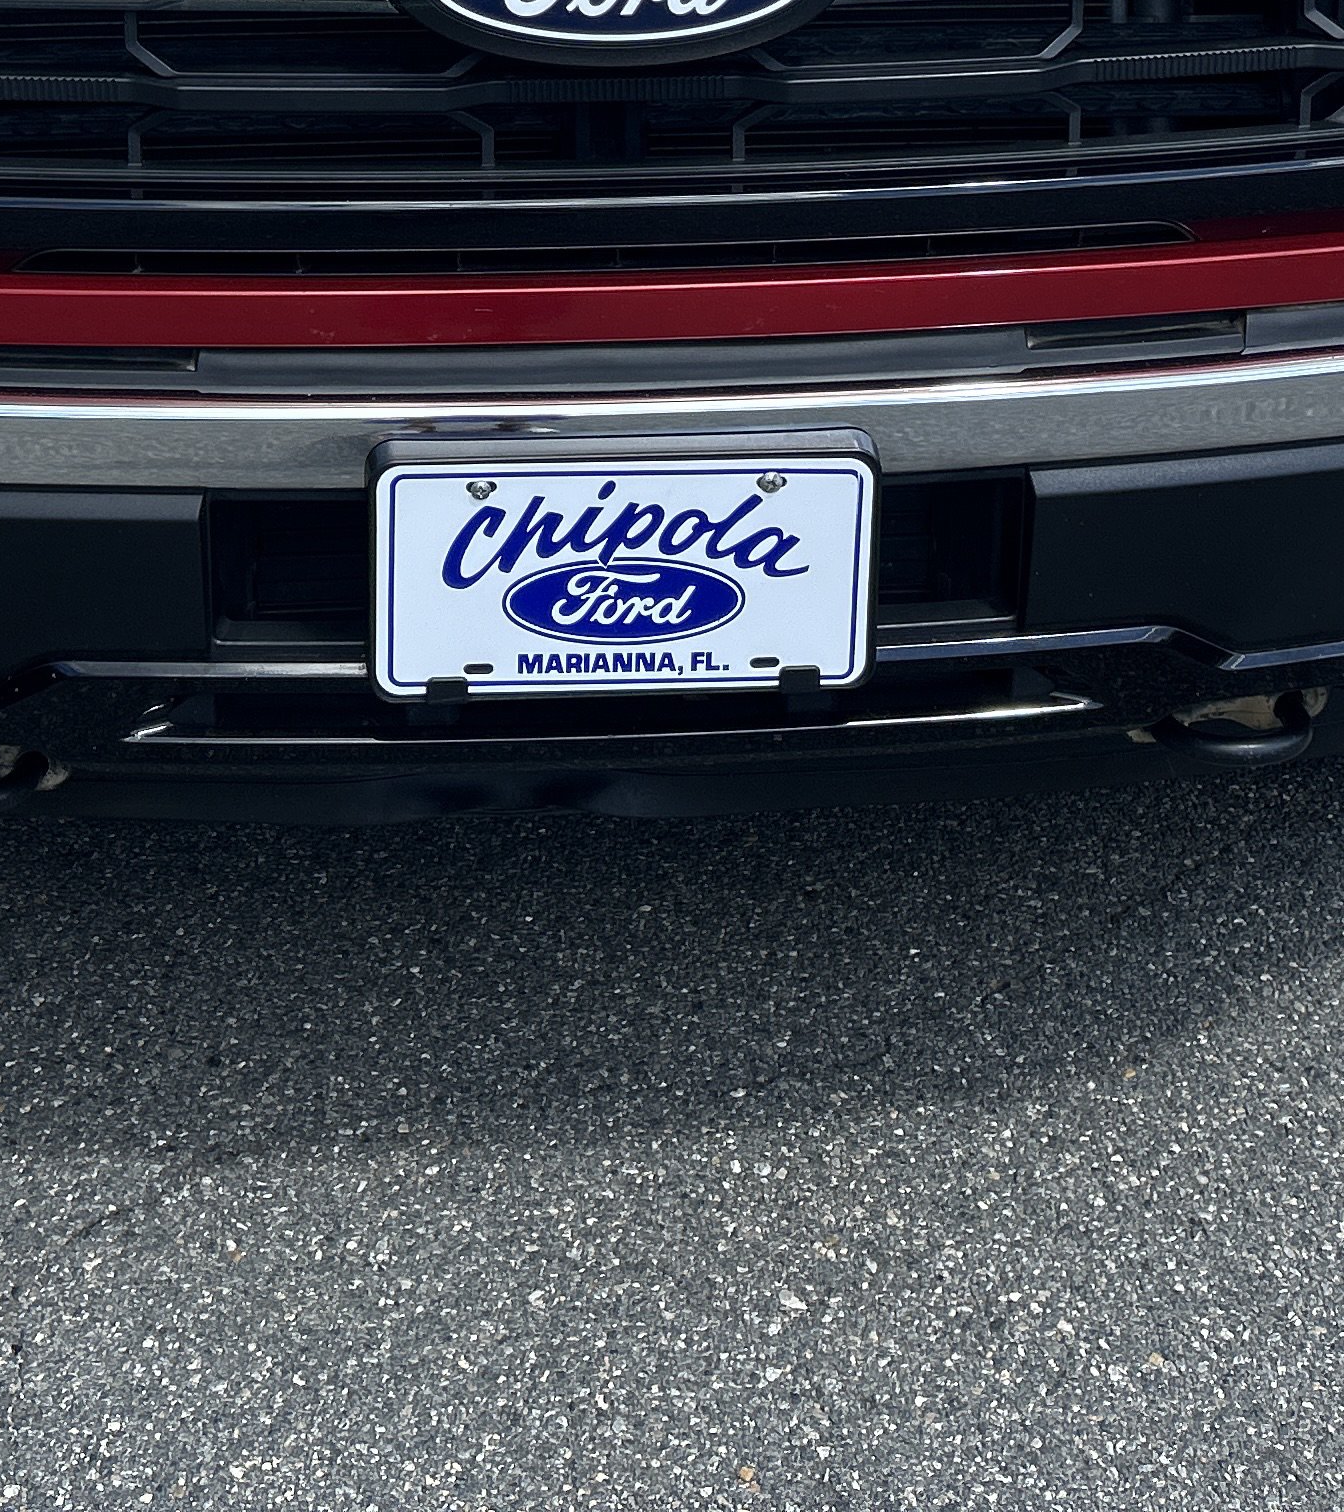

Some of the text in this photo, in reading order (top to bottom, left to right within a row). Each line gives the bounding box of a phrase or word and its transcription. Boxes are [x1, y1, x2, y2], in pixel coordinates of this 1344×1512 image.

[442, 480, 810, 589] Chipola
[552, 571, 697, 625] Ford
[517, 650, 730, 676] MARIANNA, FL.
